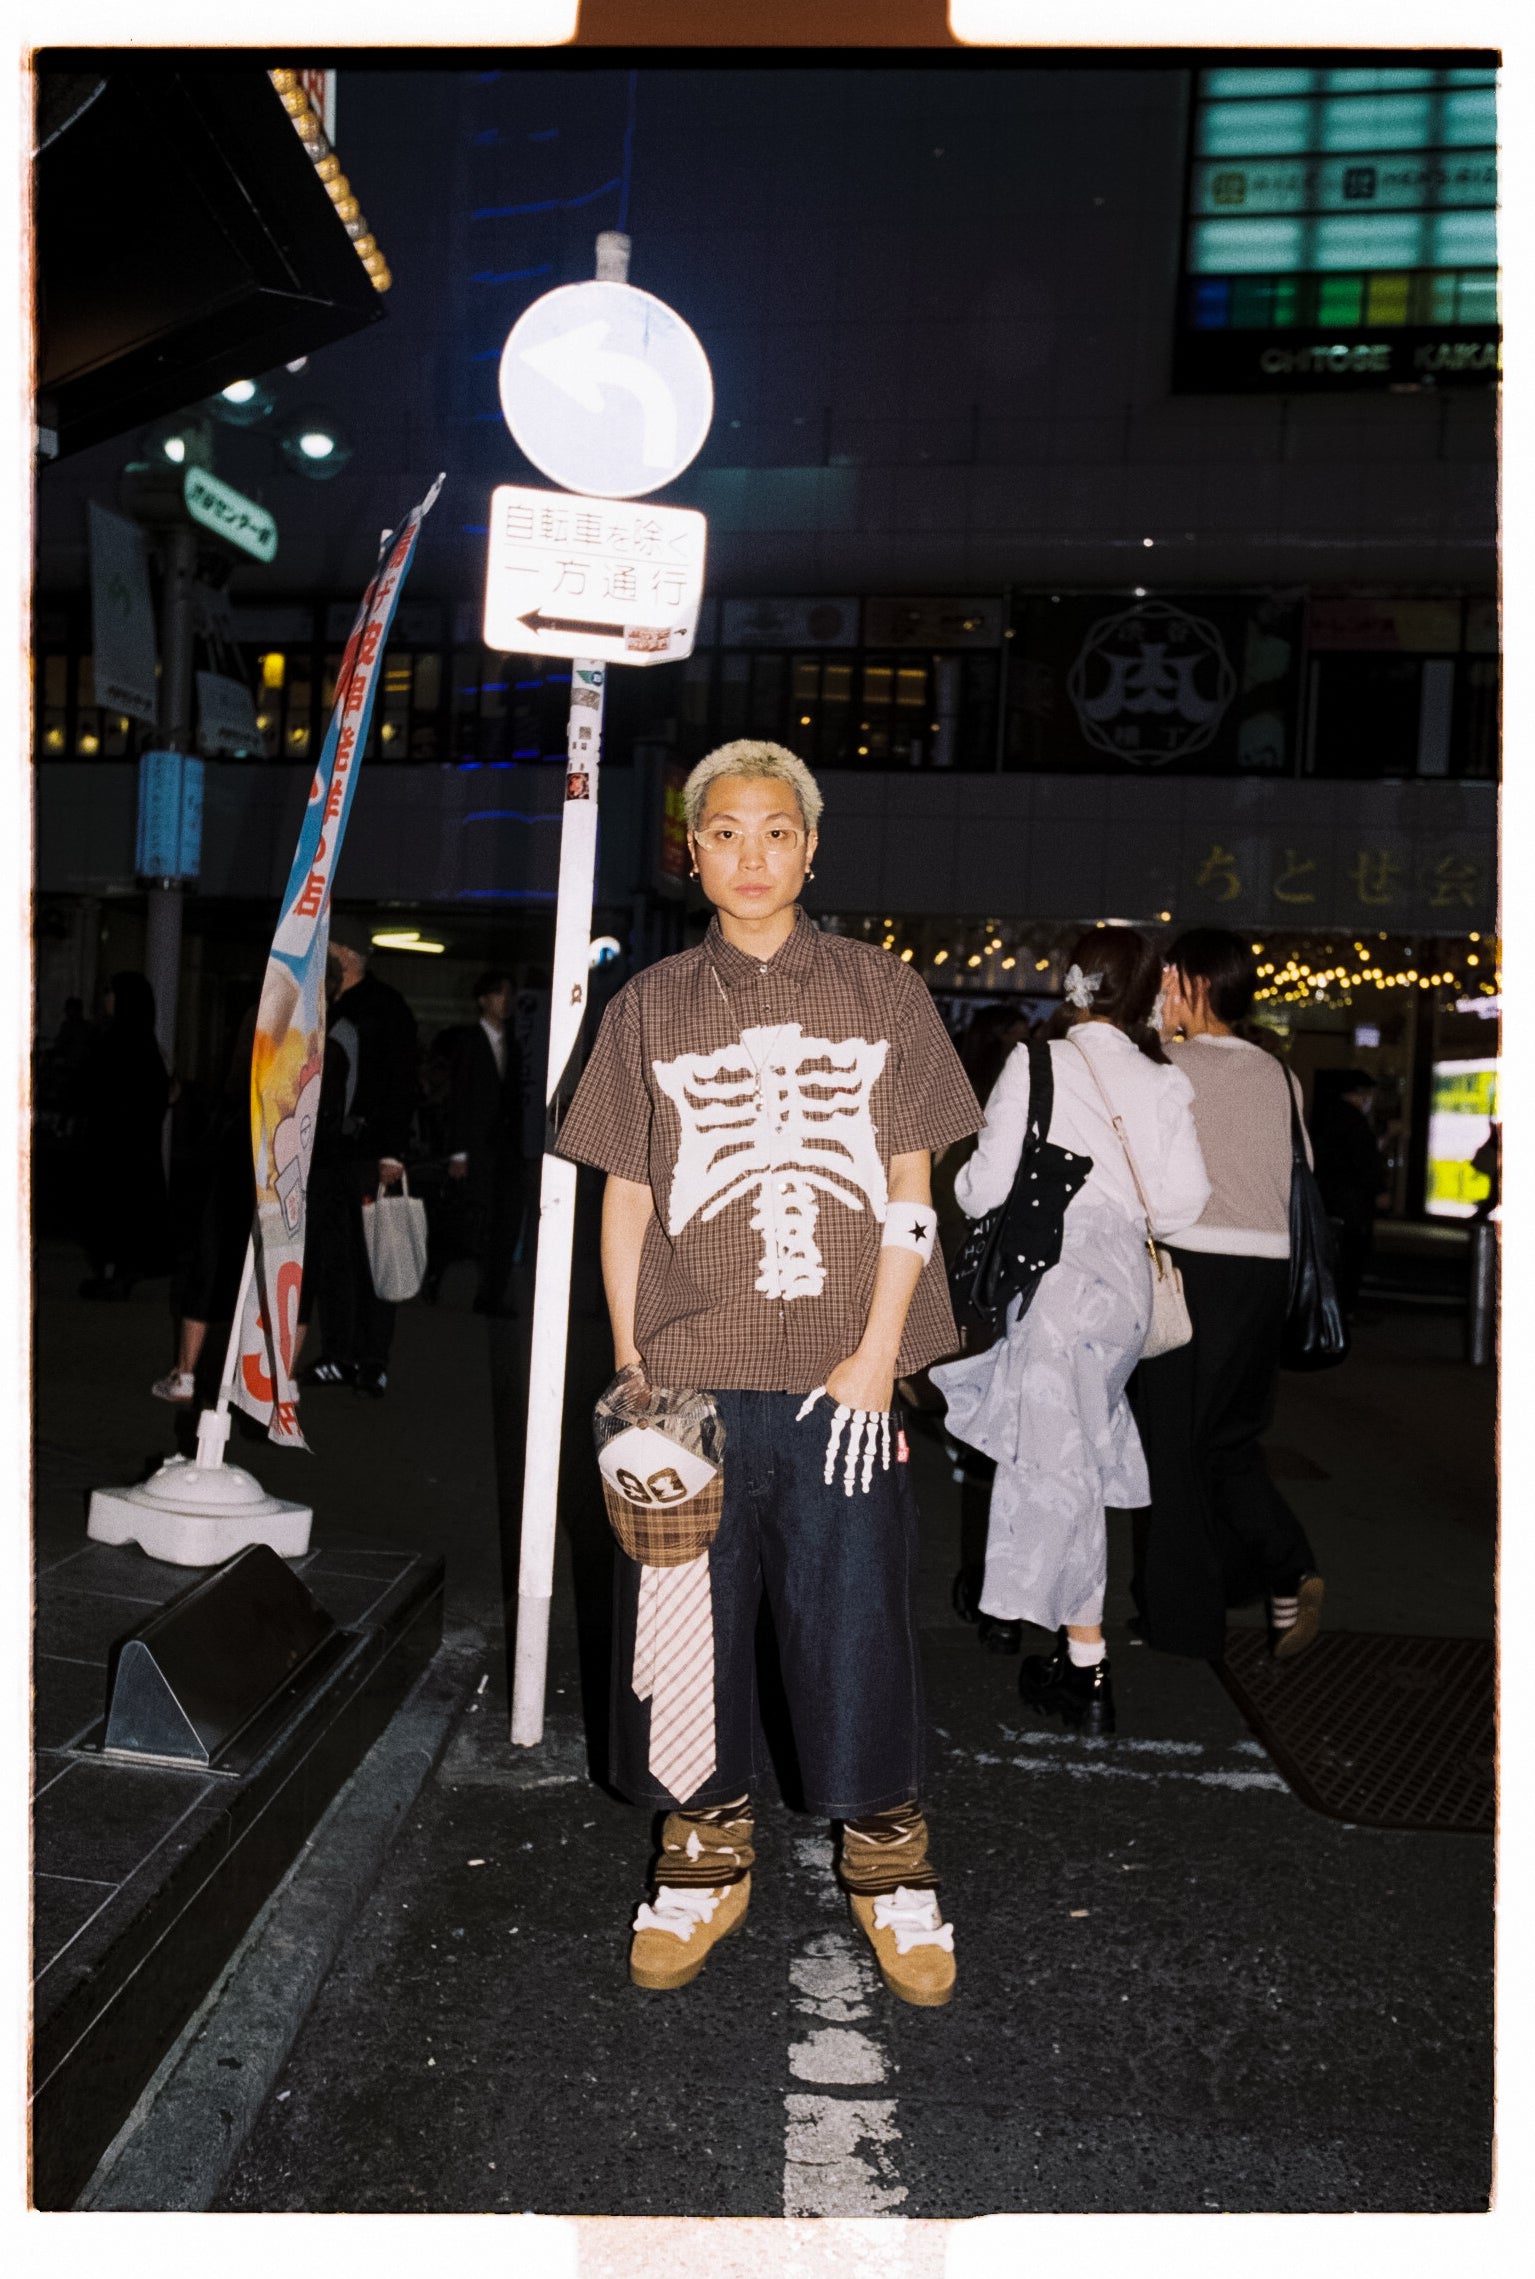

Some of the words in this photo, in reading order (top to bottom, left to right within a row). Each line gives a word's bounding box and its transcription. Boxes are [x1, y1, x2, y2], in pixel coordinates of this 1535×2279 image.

[1260, 345, 1392, 373] CHITOSE
[506, 505, 689, 557] 自転車を除く
[504, 561, 688, 606] 一方通行
